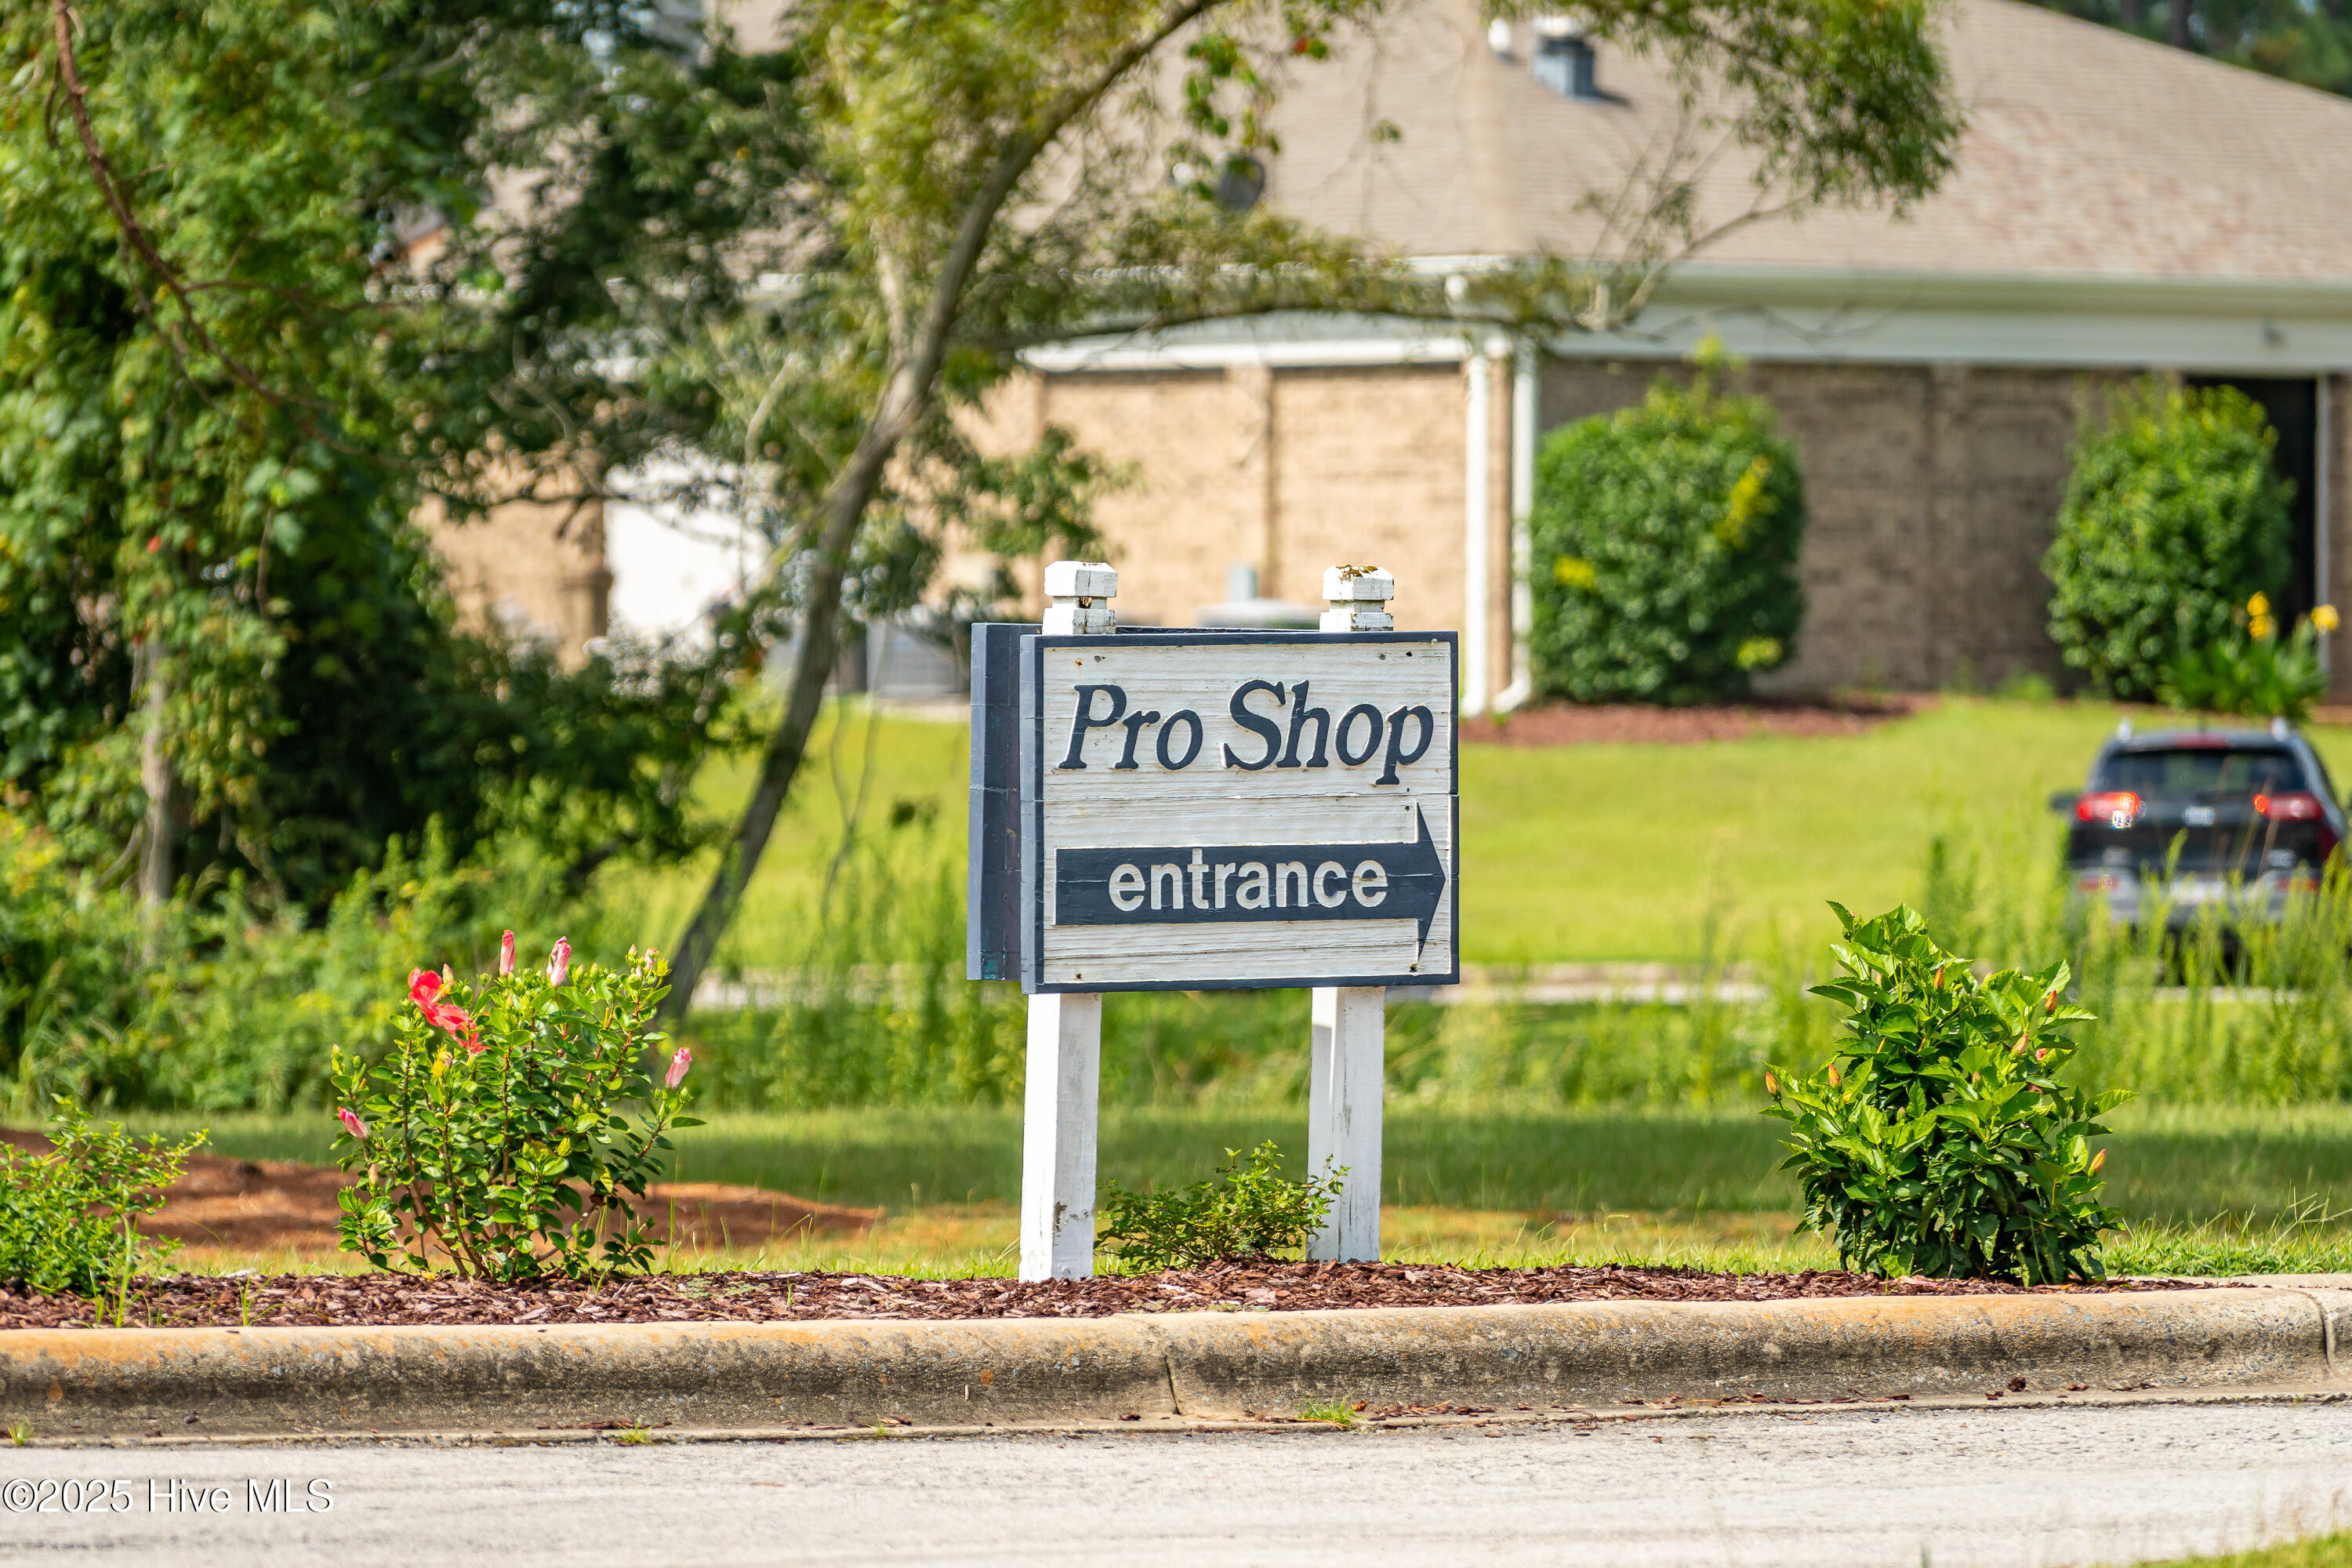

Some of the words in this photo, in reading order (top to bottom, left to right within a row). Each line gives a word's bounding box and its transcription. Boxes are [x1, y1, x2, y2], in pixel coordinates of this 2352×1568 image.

[1058, 684, 1203, 771] Pro
[1221, 679, 1433, 785] Shop
[1109, 848, 1388, 911] entrance
